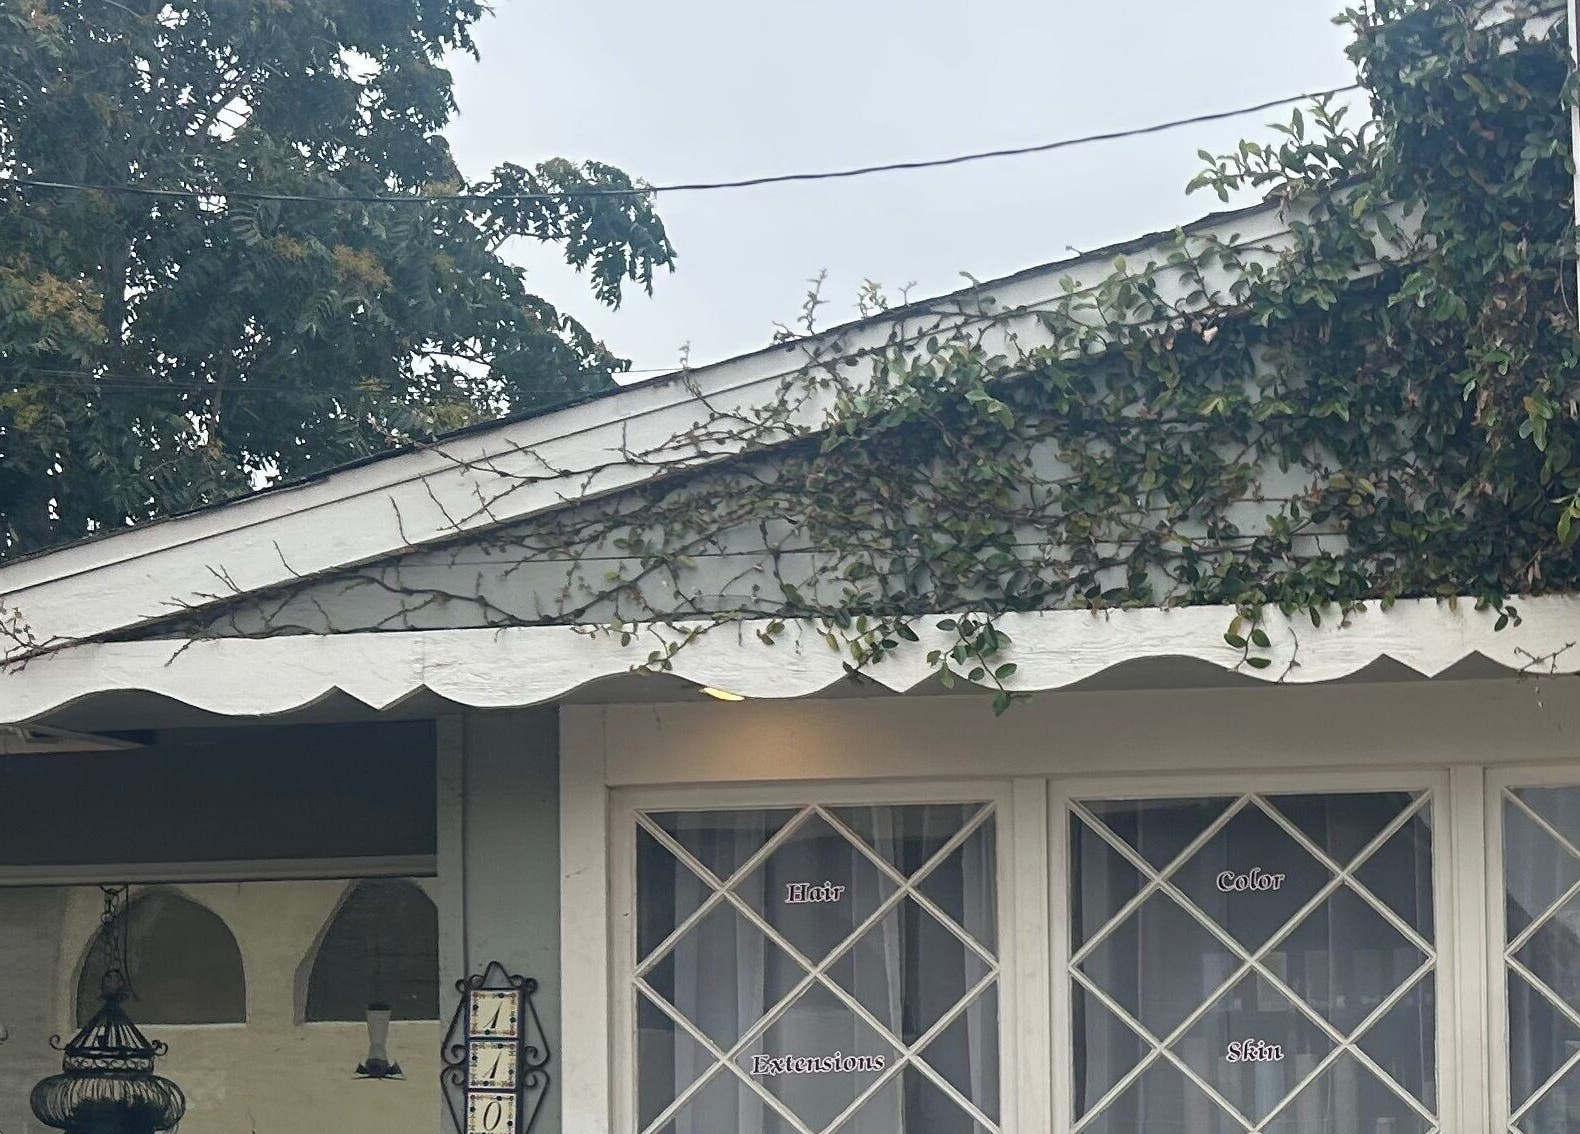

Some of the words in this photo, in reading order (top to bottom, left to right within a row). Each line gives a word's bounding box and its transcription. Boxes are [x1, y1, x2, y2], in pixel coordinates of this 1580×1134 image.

[784, 880, 846, 904] Hair
[1216, 867, 1286, 892] Color
[1226, 1038, 1285, 1063] Skin
[750, 1050, 886, 1077] Extensions
